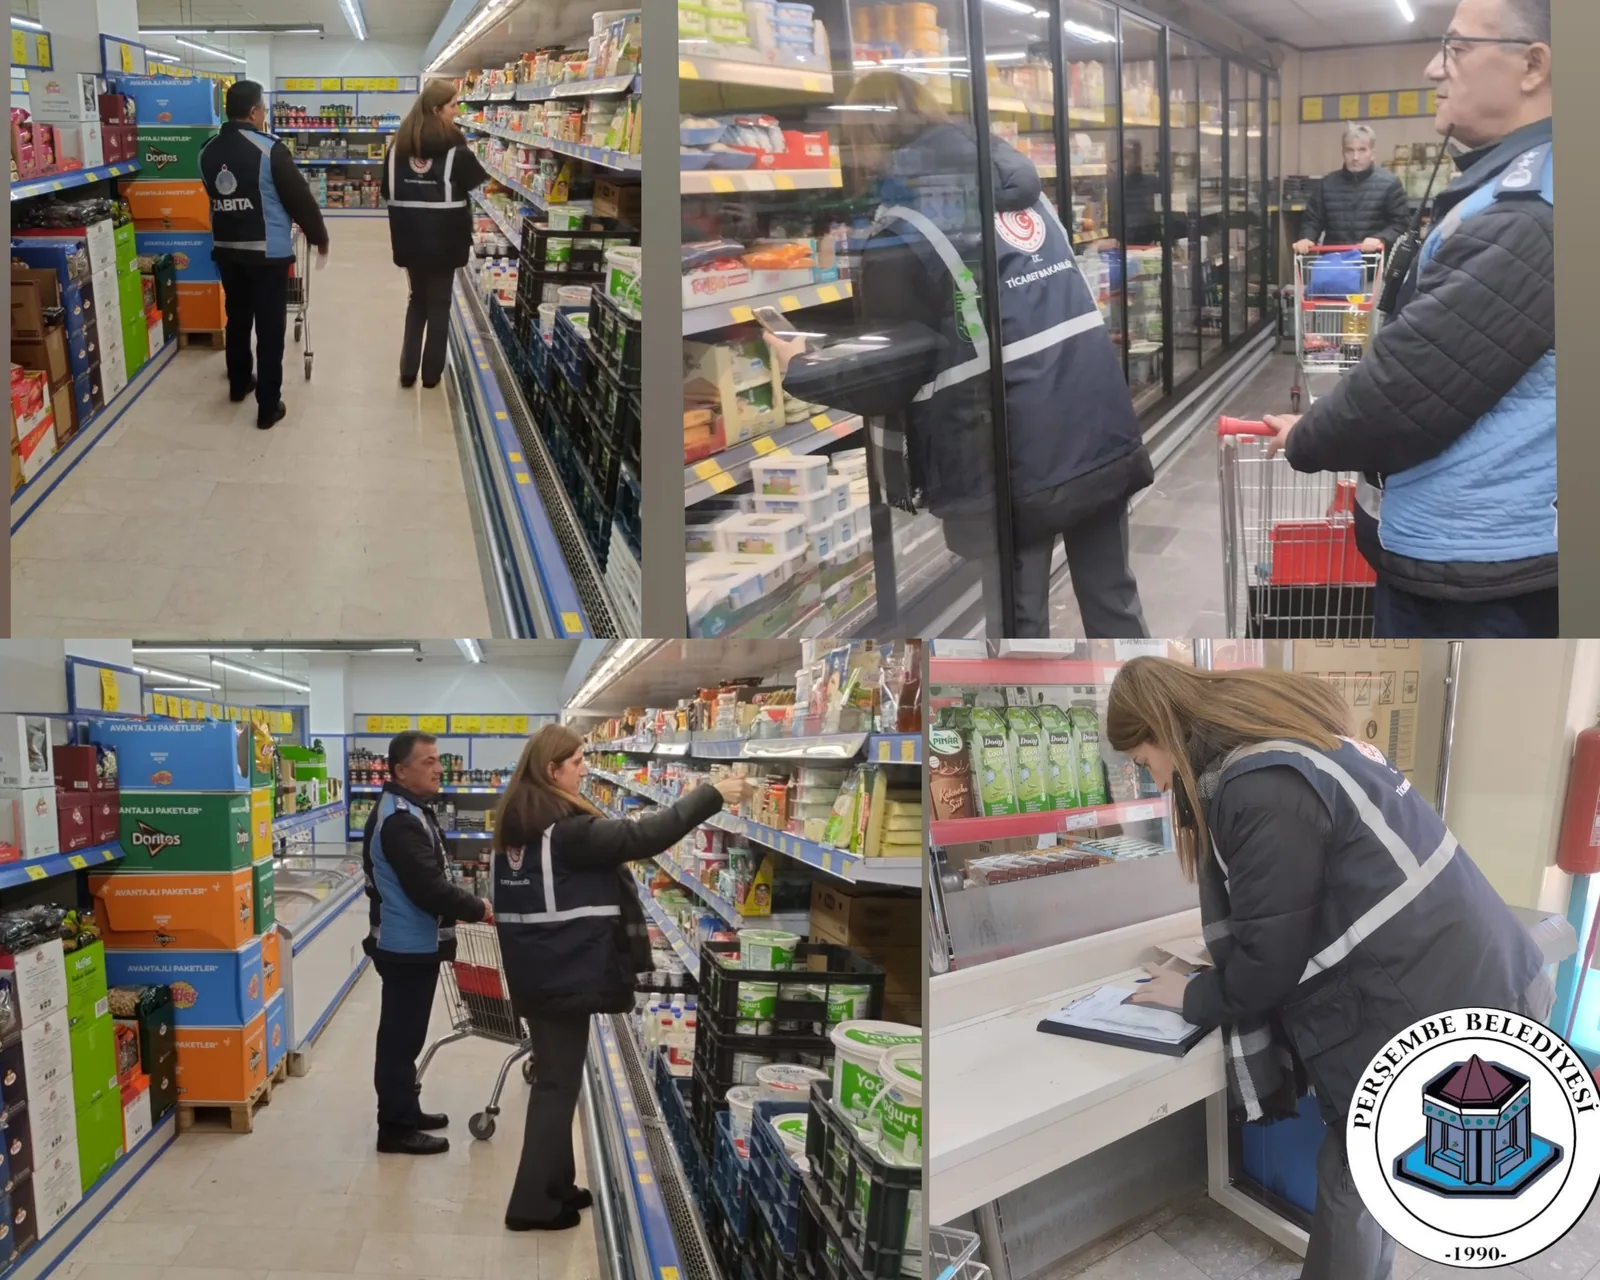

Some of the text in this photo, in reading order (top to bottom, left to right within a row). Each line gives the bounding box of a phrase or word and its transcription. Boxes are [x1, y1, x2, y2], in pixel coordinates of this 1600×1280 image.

[145, 153, 178, 162] Doritos
[212, 198, 254, 212] ZABITA
[1005, 273, 1039, 289] TİCARET
[110, 724, 157, 732] AVANTAJLI
[118, 807, 154, 815] ANTAJLI
[132, 832, 181, 846] Doritos
[114, 888, 161, 897] AVANTAJLI
[127, 965, 172, 973] AVANTAJLI
[882, 1097, 919, 1128] oğurt
